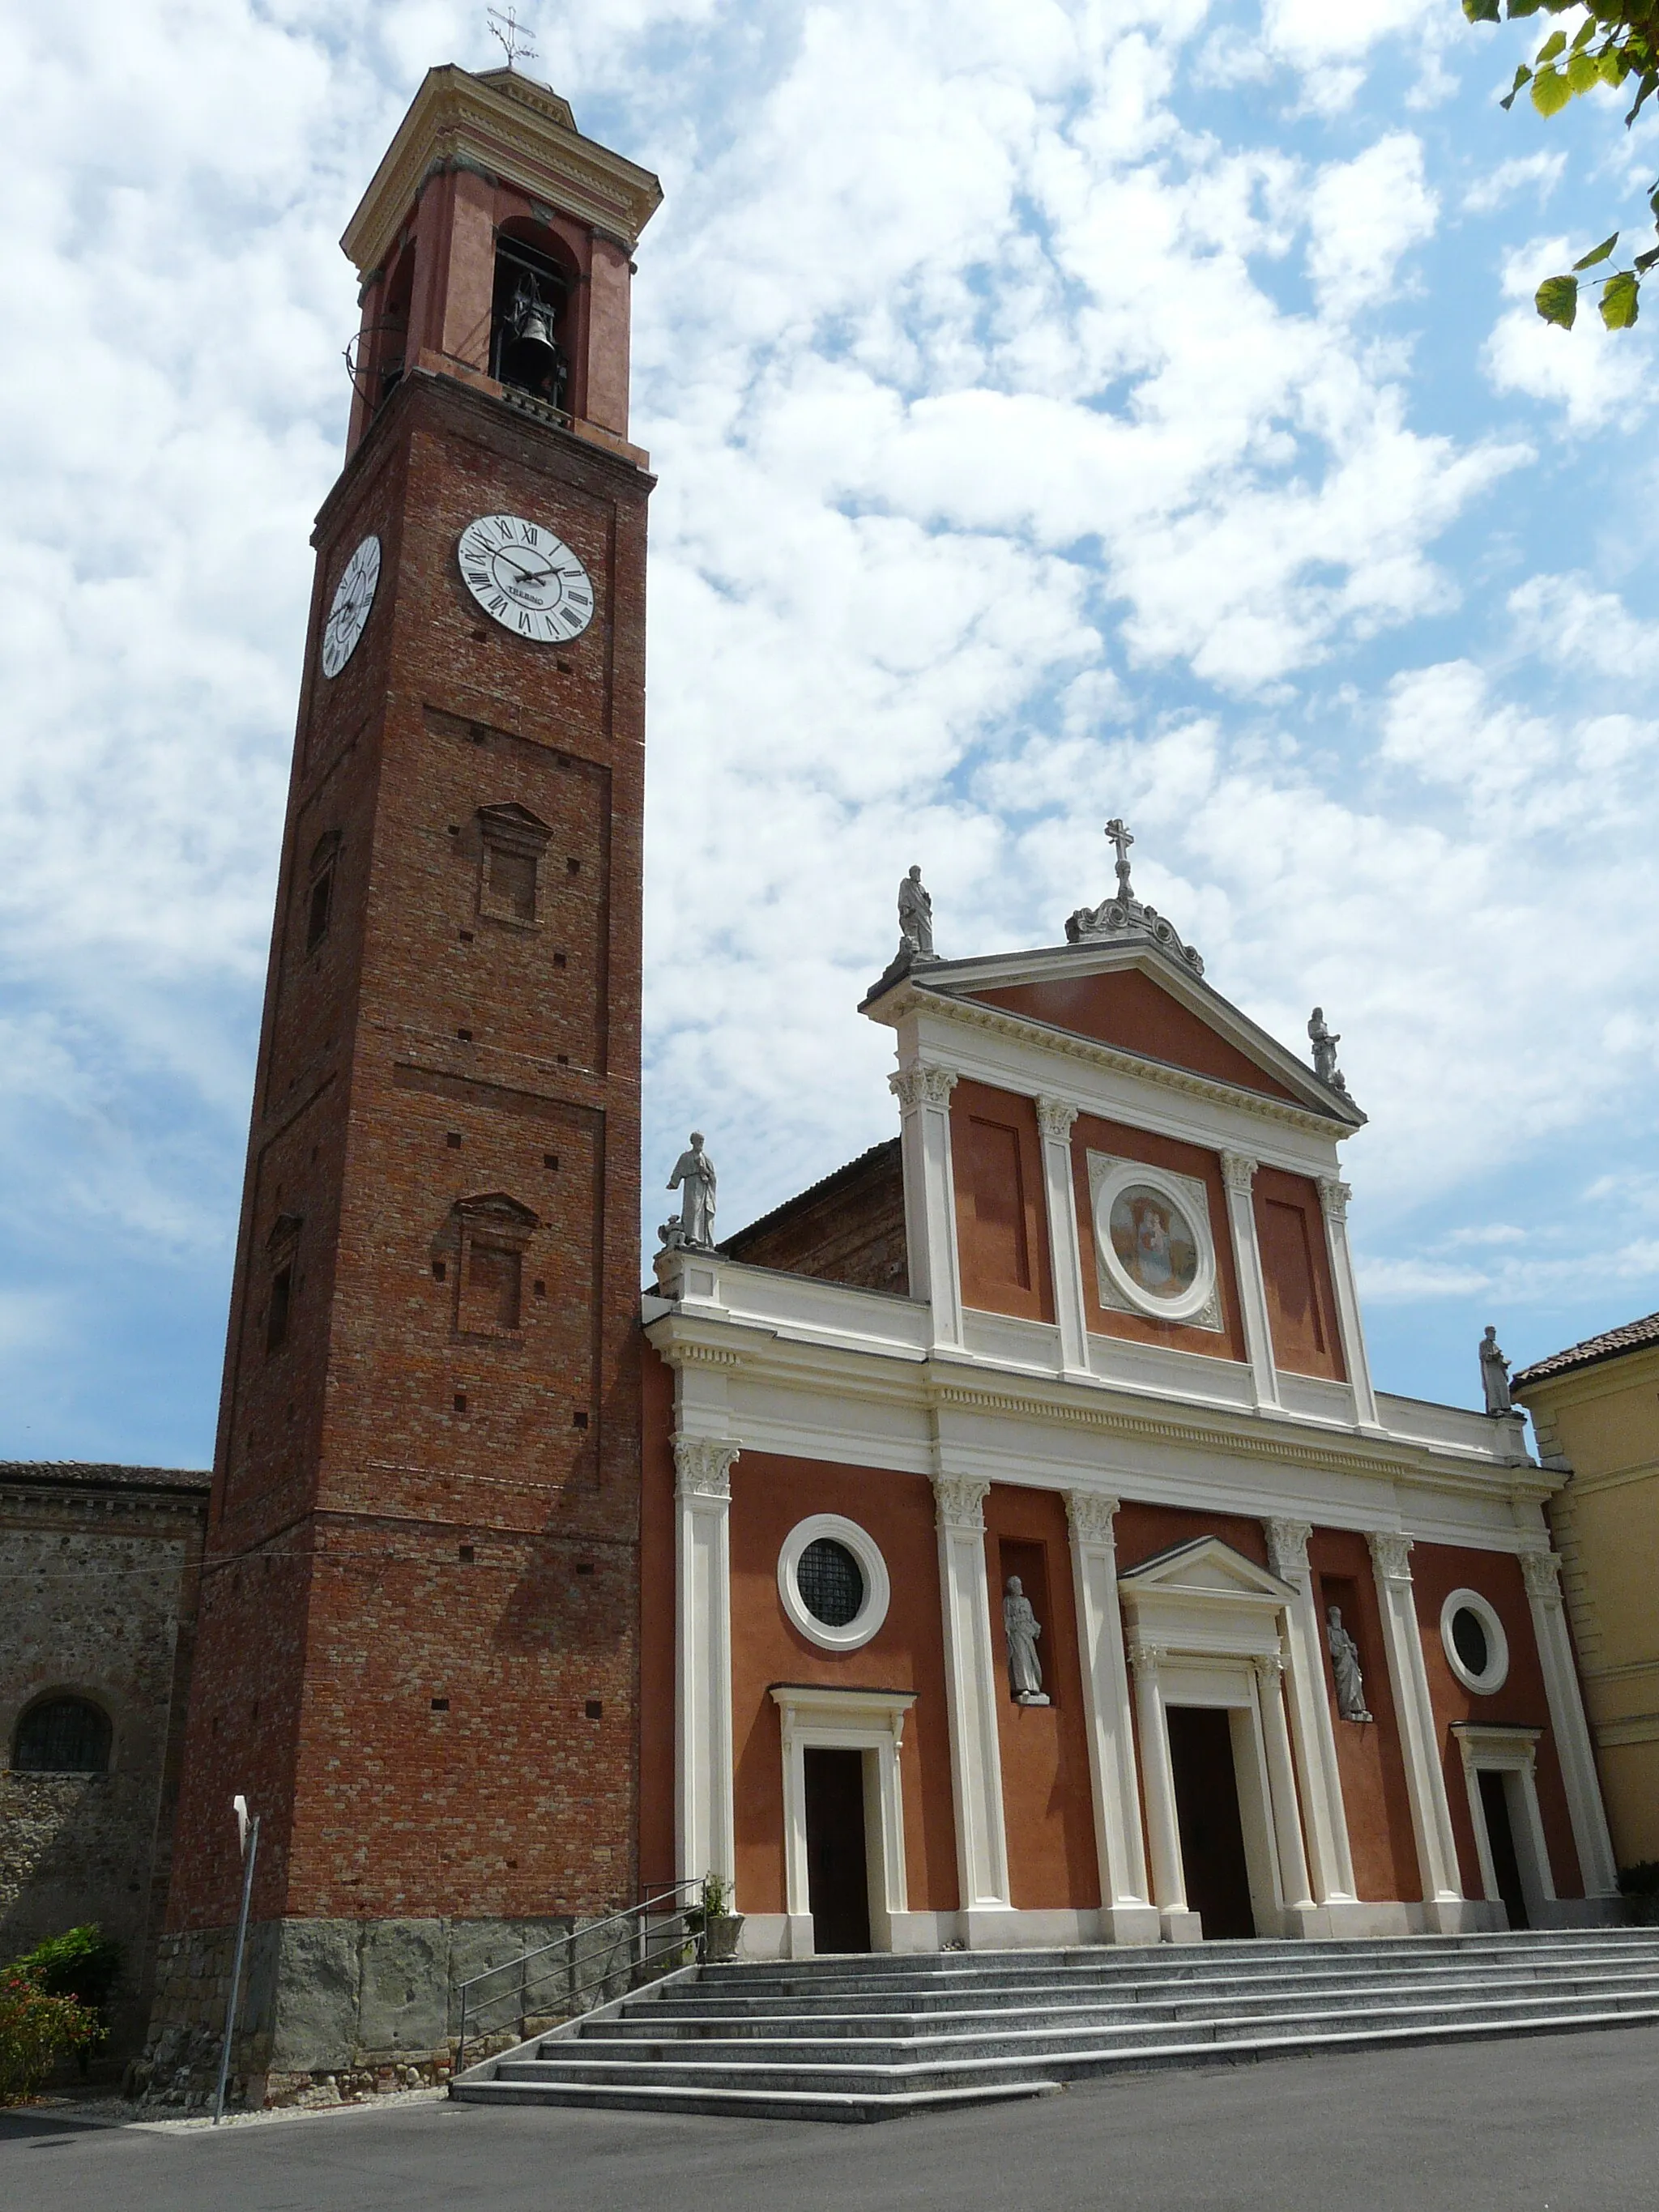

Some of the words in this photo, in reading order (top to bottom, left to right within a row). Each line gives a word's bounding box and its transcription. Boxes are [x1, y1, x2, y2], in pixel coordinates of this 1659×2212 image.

[493, 520, 514, 539] XI
[521, 524, 538, 547] XII
[464, 548, 486, 566] IX
[548, 544, 560, 557] I
[467, 573, 493, 591] VIII
[488, 595, 508, 616] VII
[568, 590, 589, 606] III
[518, 611, 531, 633] VI
[545, 616, 560, 636] V
[560, 607, 582, 629] IIII
